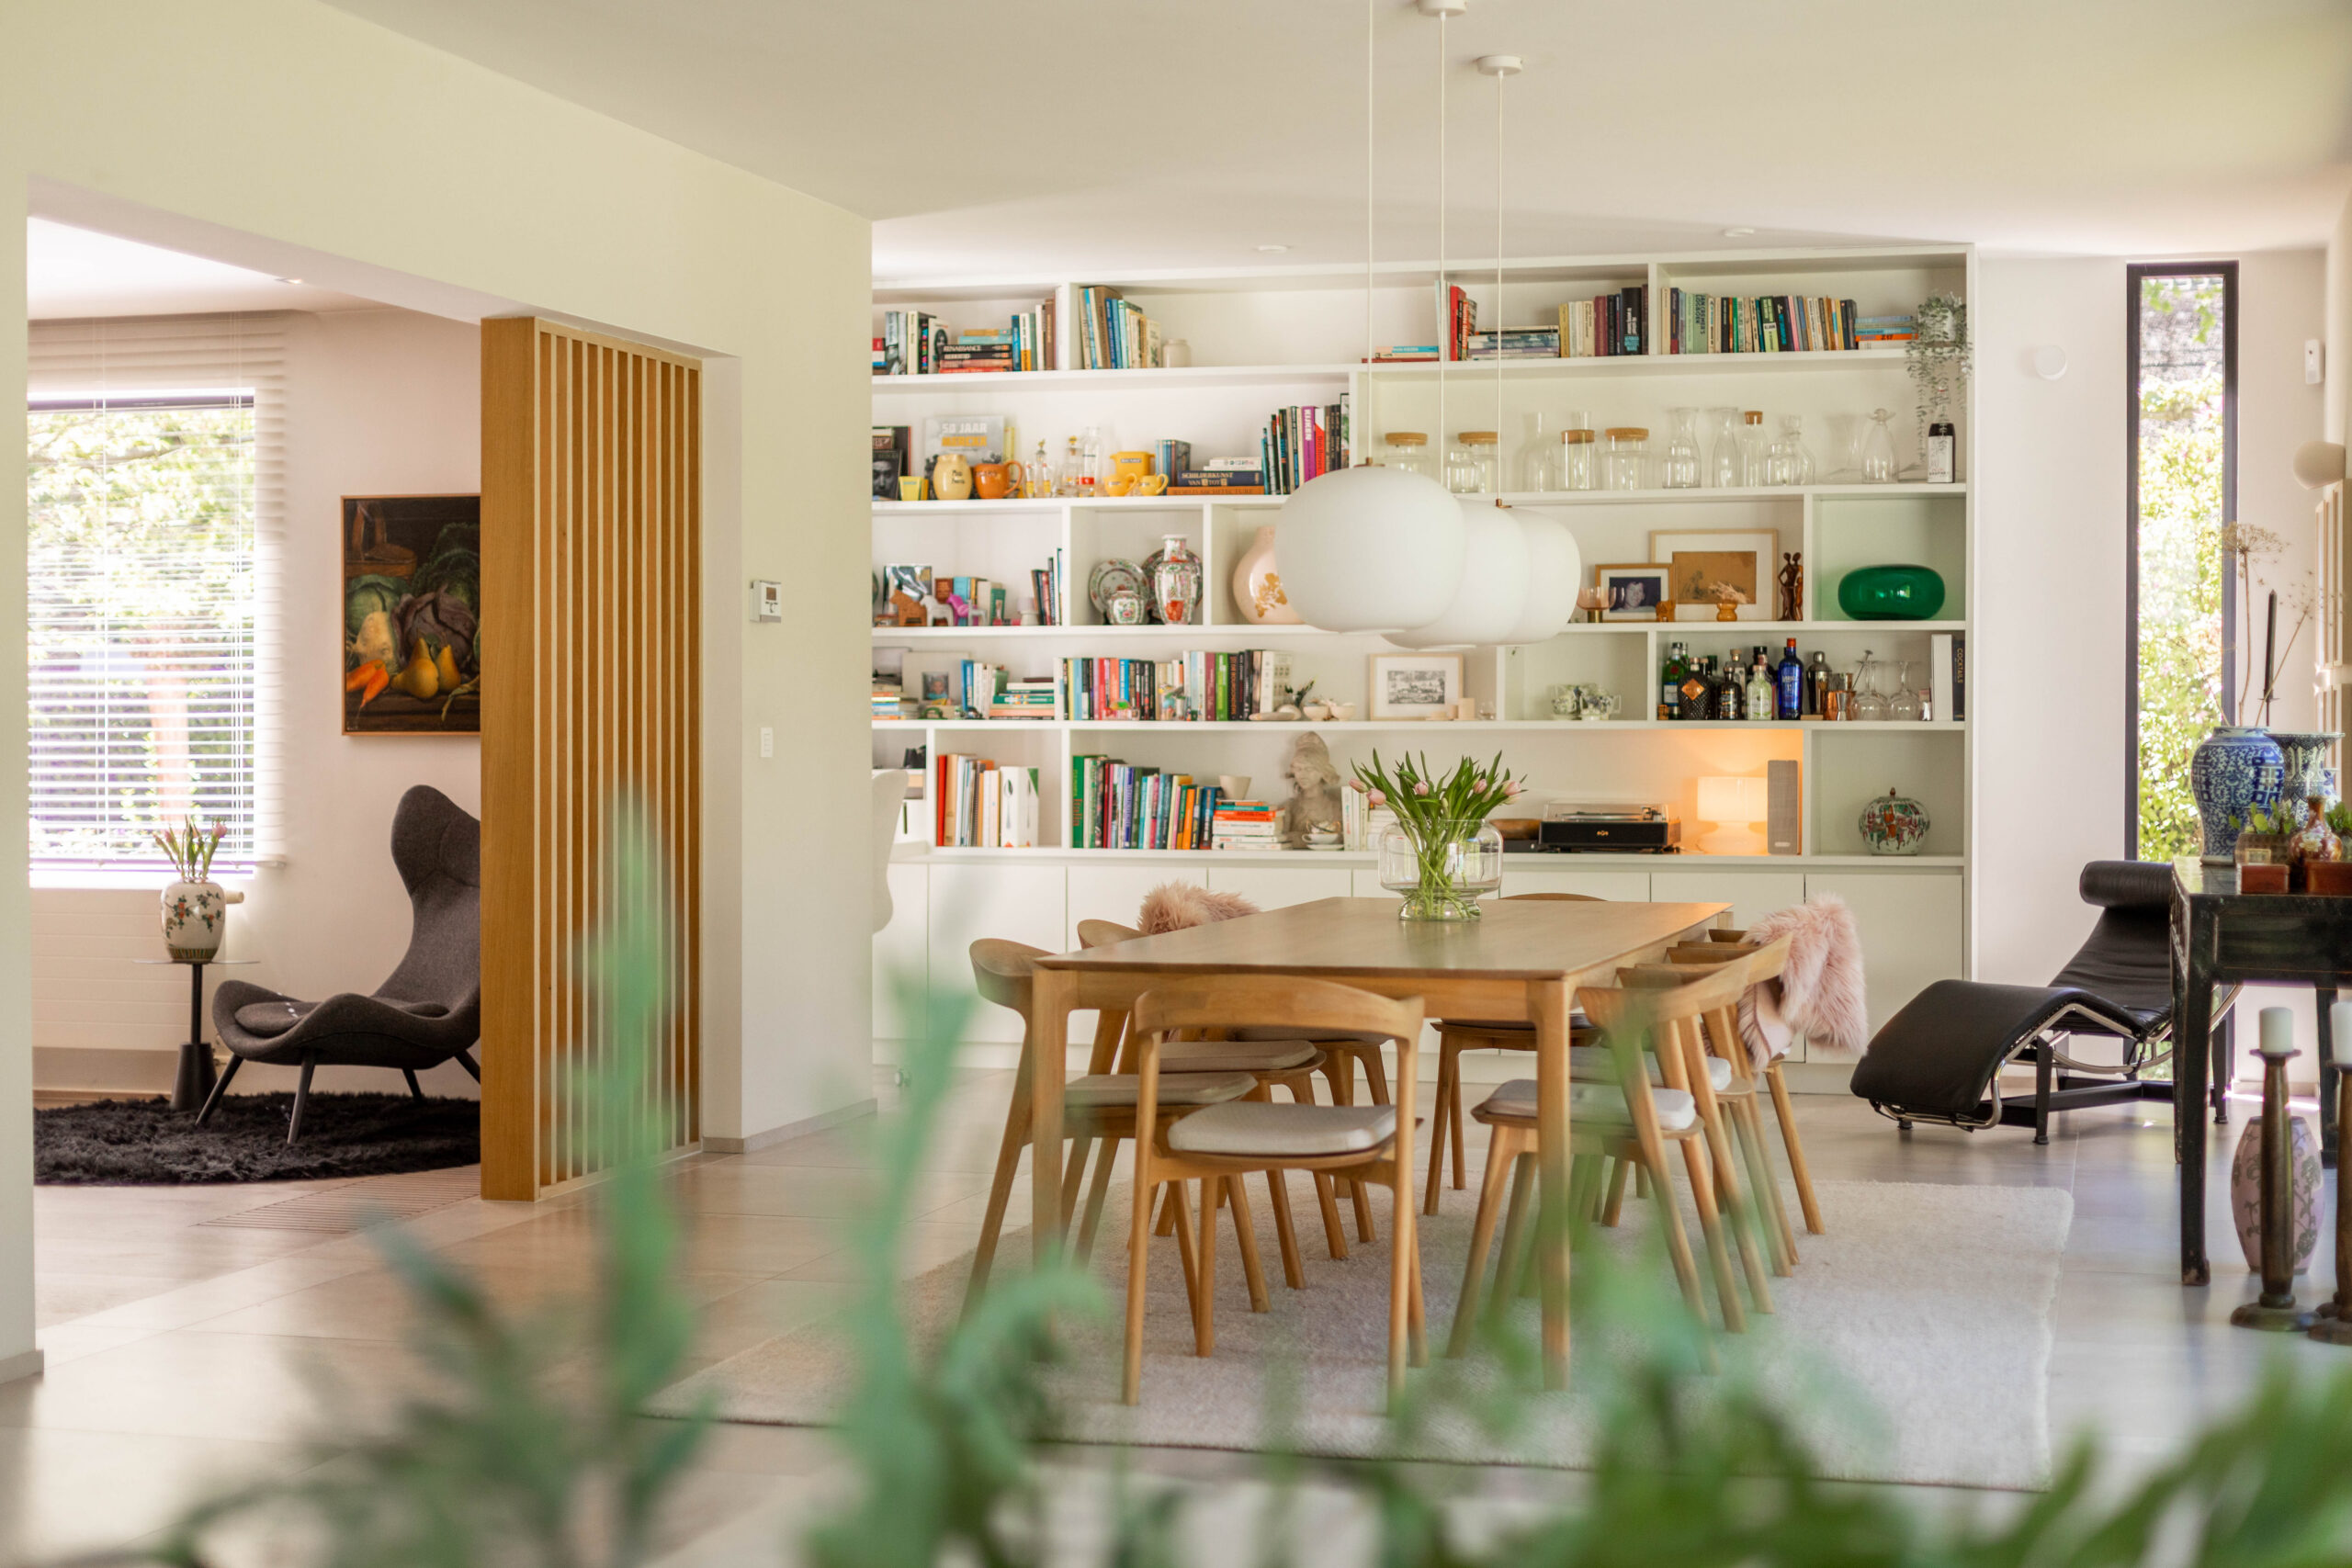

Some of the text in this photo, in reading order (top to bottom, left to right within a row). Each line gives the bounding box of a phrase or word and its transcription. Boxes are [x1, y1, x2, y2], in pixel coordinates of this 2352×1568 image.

[942, 423, 988, 434] 50 JAAR
[941, 435, 988, 447] MERCKX
[1073, 798, 1083, 827] Italia
